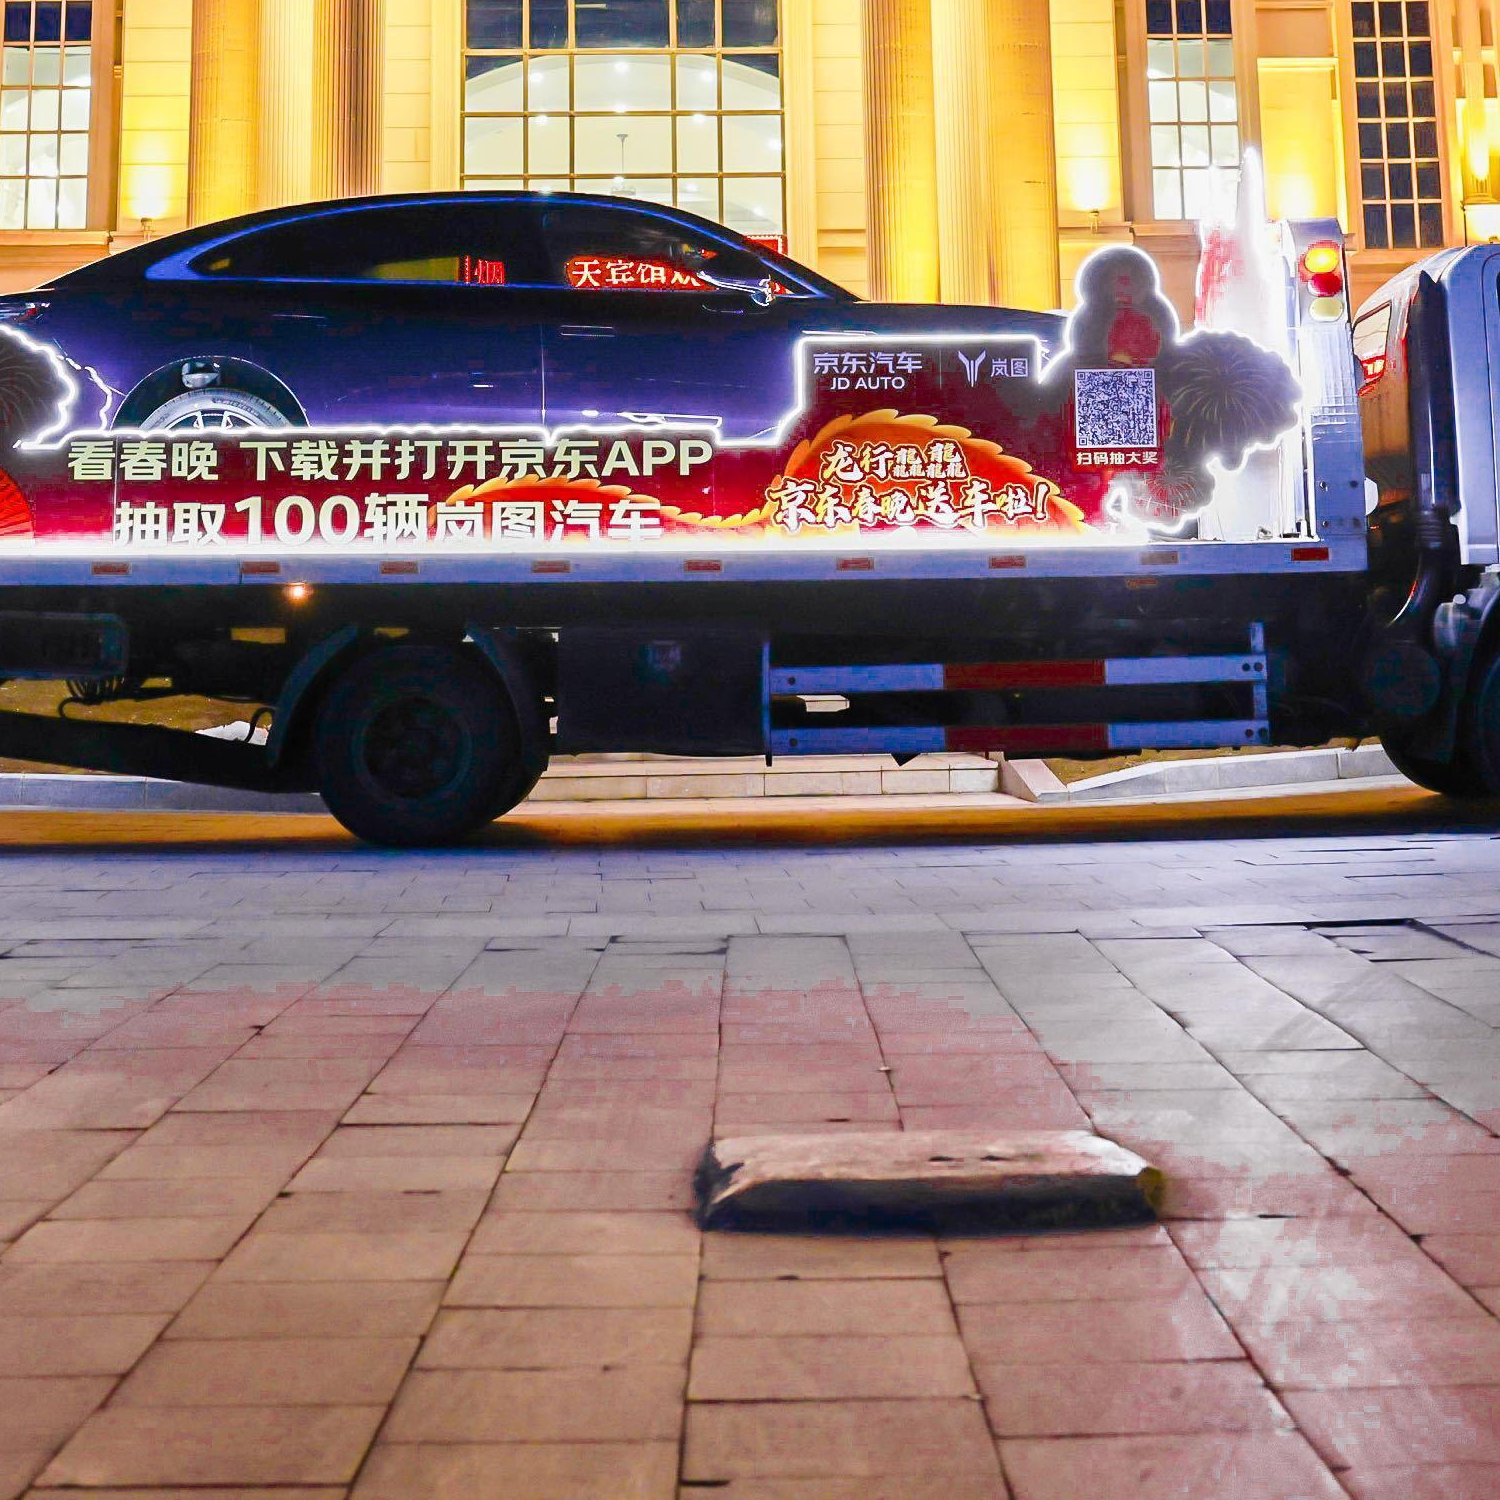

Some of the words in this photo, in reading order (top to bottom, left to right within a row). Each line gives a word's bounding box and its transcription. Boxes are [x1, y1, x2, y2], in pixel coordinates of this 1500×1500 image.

[813, 352, 923, 374] 京东汽车
[991, 358, 1029, 377] 岚图
[830, 377, 850, 390] JD
[855, 377, 905, 390] AUTO
[68, 441, 219, 481] 看春晚
[240, 438, 713, 481] 下载并打开京东APP
[1076, 451, 1158, 466] 扫码抽大奖
[113, 492, 663, 548] 抽取100辆岚图汽车
